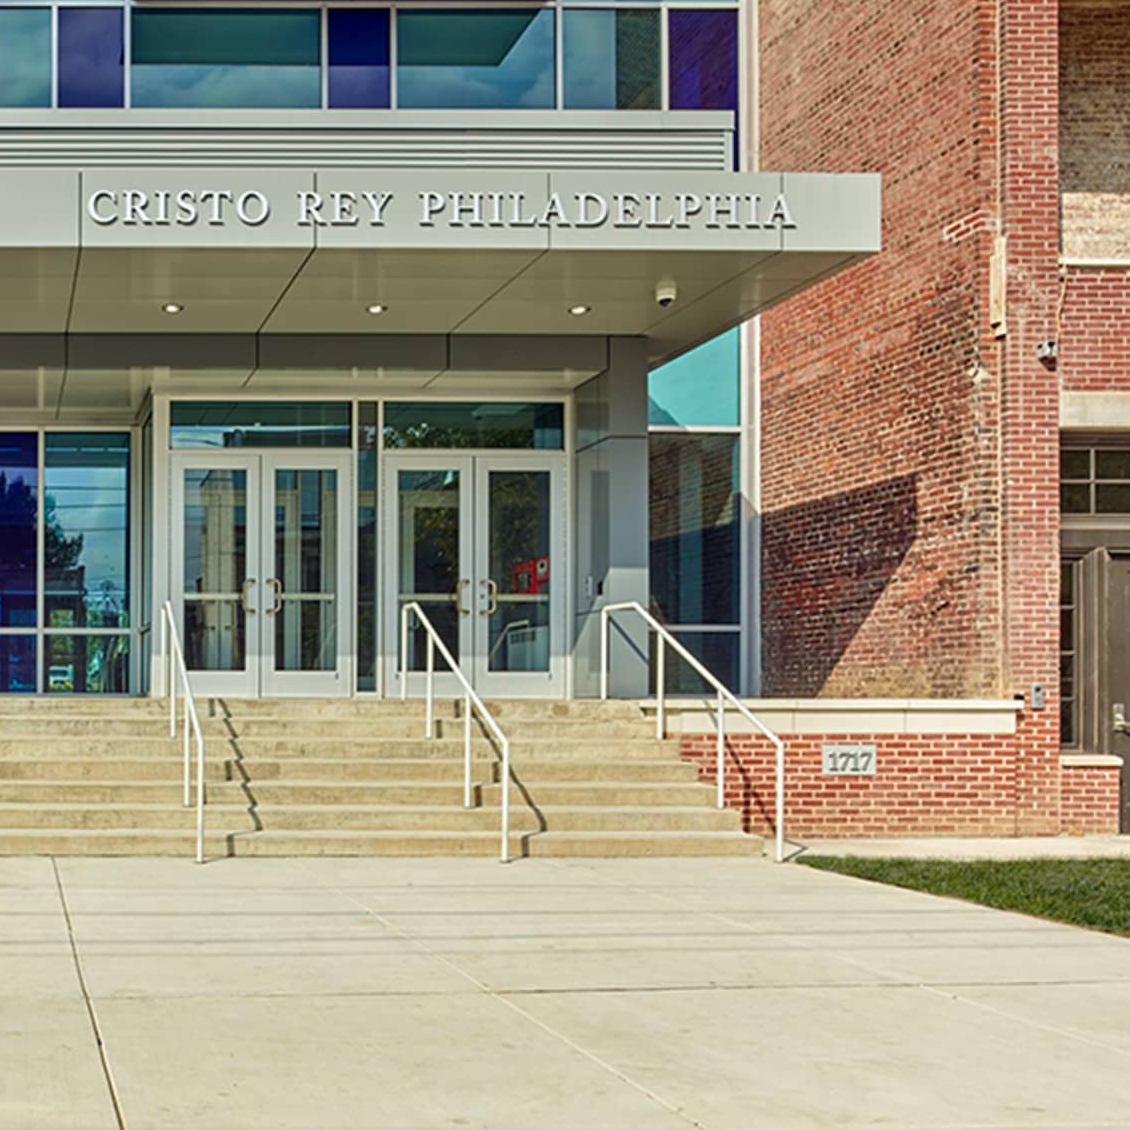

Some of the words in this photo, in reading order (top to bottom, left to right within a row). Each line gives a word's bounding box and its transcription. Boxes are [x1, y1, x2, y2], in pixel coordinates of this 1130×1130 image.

[87, 188, 271, 227] CRISTO
[297, 190, 393, 227] REY
[419, 190, 797, 229] PHILADELPHIA
[828, 751, 873, 772] 1717
